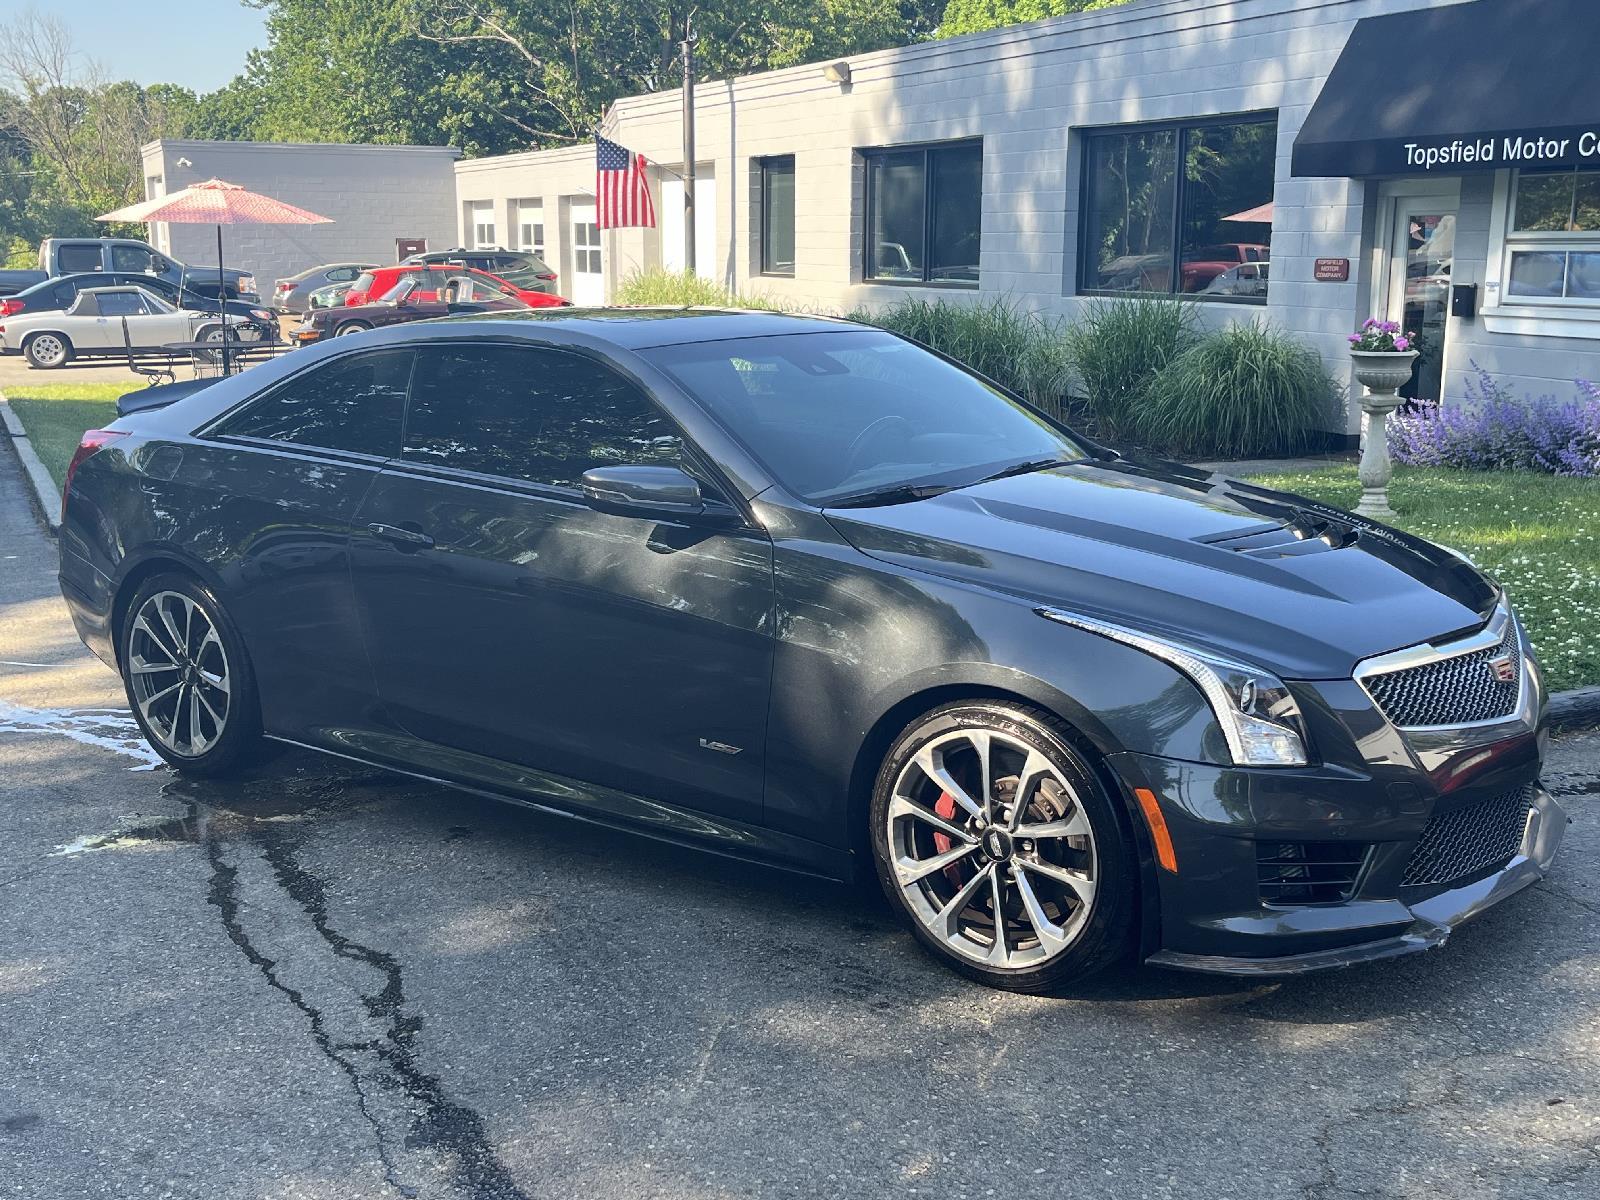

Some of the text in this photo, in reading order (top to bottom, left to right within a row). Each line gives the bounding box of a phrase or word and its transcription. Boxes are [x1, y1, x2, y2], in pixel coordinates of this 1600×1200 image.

[1404, 131, 1600, 169] Topsfield Motor C
